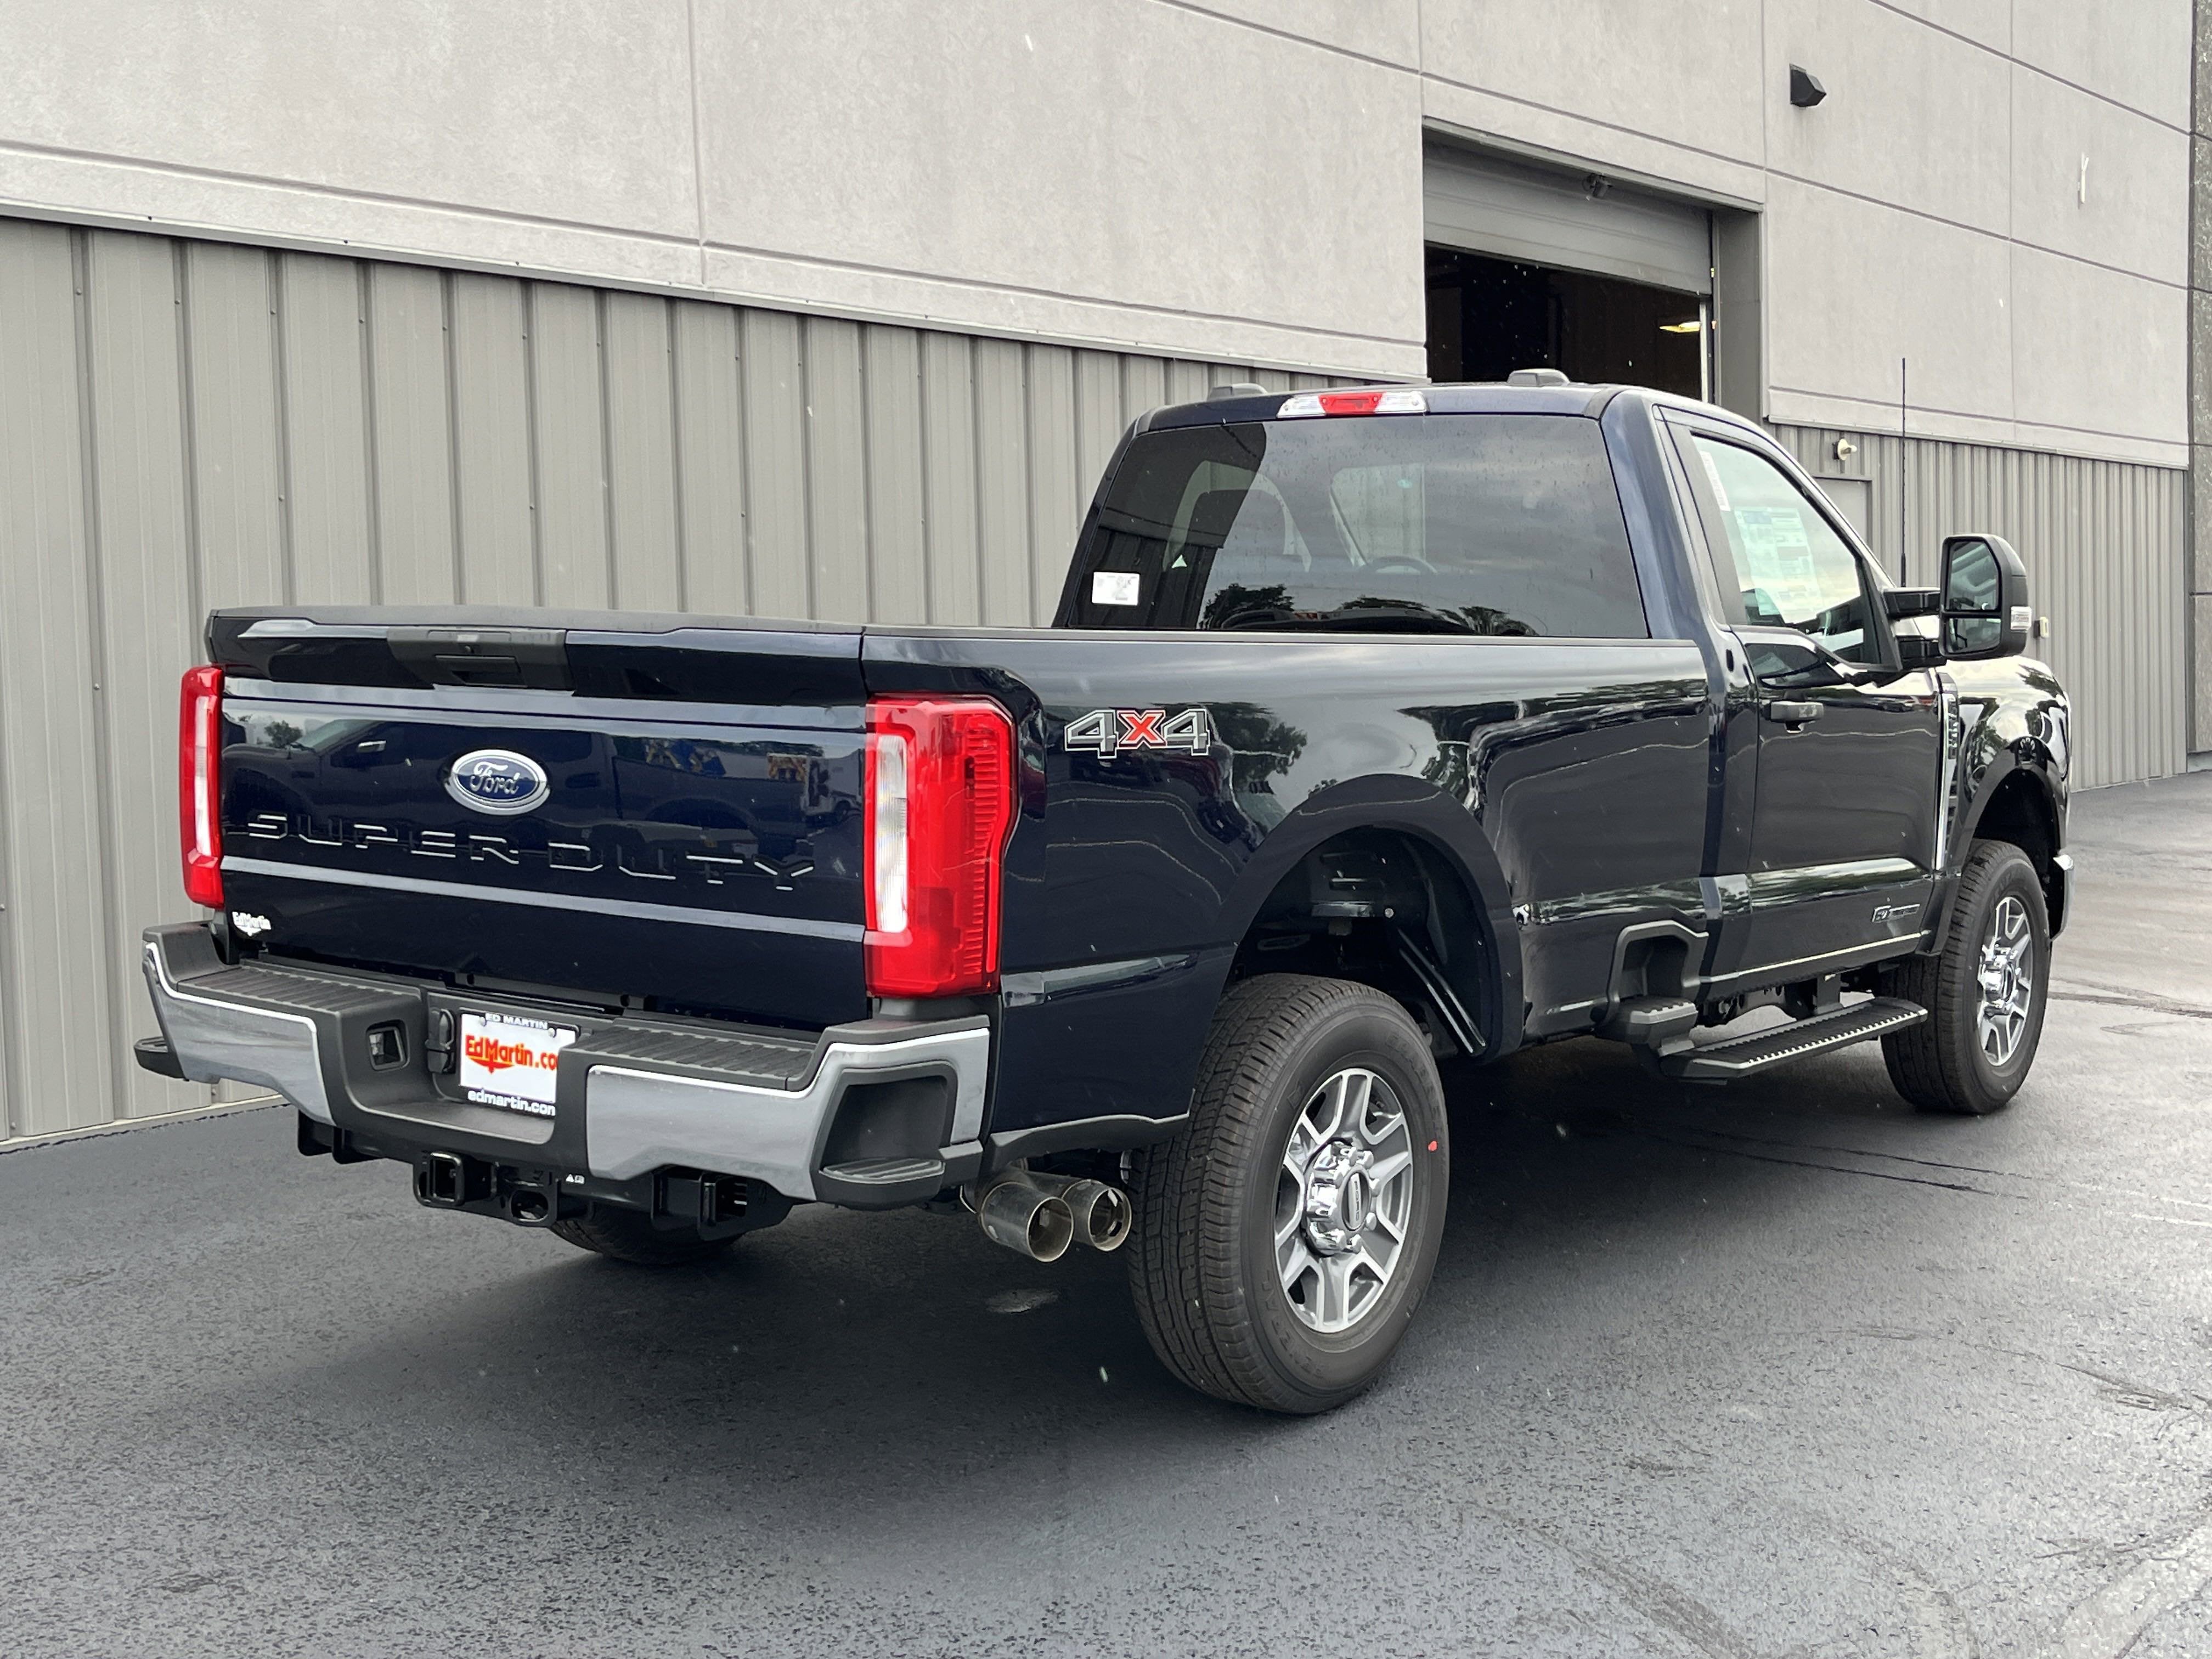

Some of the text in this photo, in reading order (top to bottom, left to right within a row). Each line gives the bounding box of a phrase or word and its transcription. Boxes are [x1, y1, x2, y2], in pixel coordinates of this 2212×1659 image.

[470, 761, 521, 794] Ford
[247, 810, 815, 891] SUPER DUTY
[486, 1013, 548, 1029] ED MARTIN
[466, 1035, 557, 1070] EdMartin.co
